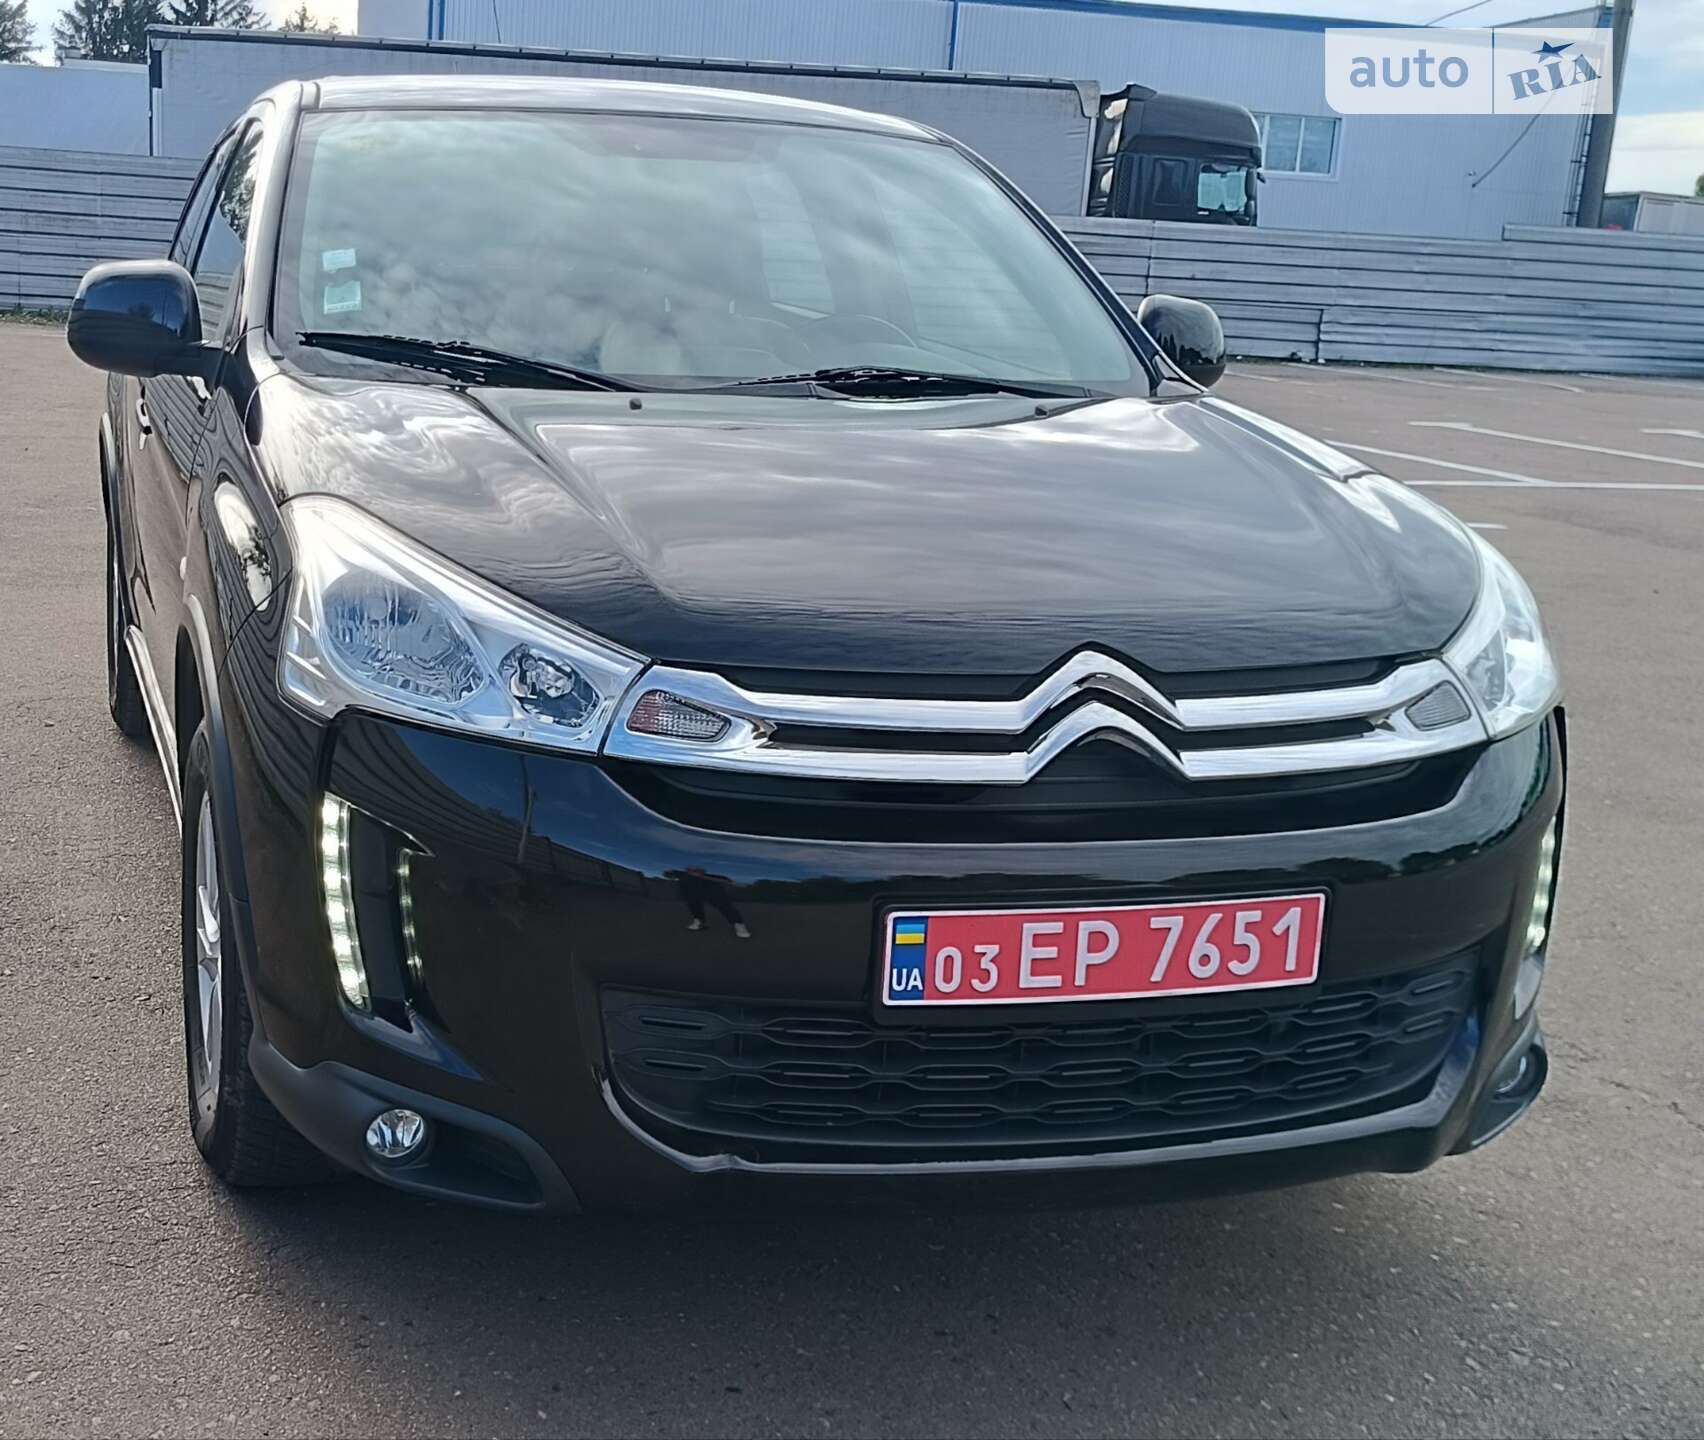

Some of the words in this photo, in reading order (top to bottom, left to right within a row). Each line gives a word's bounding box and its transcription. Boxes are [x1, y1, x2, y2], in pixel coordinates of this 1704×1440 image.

[933, 944, 1000, 993] 03
[1018, 920, 1120, 989] EP
[1148, 906, 1303, 983] 7651
[891, 967, 923, 992] UA
